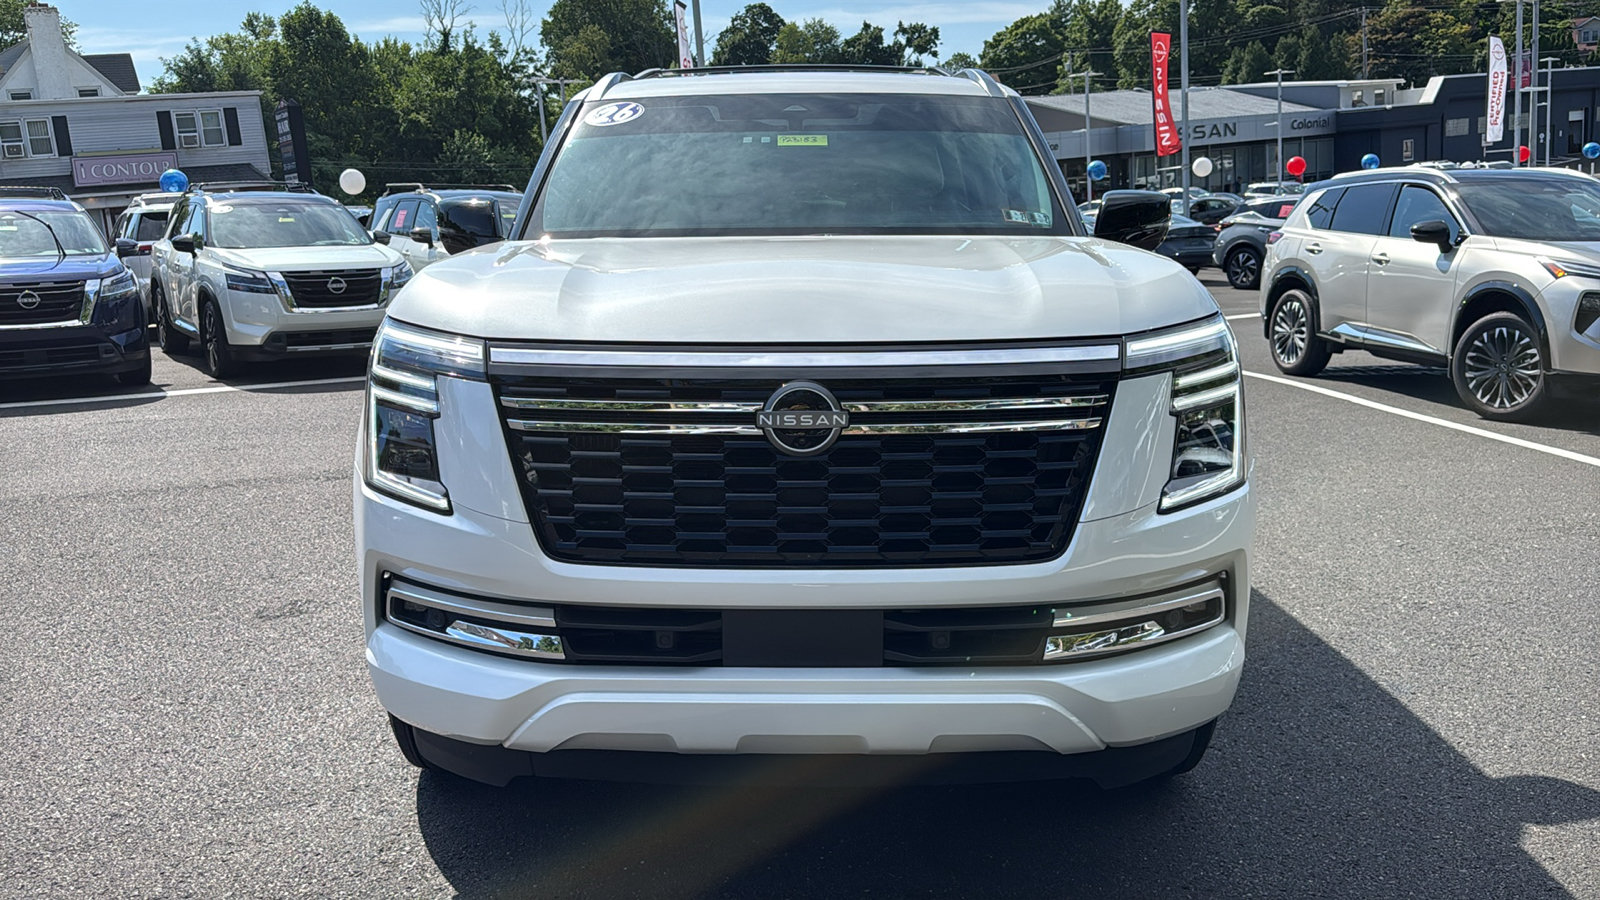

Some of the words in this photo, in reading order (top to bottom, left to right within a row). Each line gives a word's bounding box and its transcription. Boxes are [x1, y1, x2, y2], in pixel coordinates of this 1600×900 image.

[1156, 67, 1171, 146] NISSAN
[1177, 122, 1237, 141] SSAN
[1290, 117, 1330, 130] Colonial
[80, 163, 86, 179] i
[91, 161, 170, 178] CONTOUR
[759, 414, 847, 426] NISSAN
